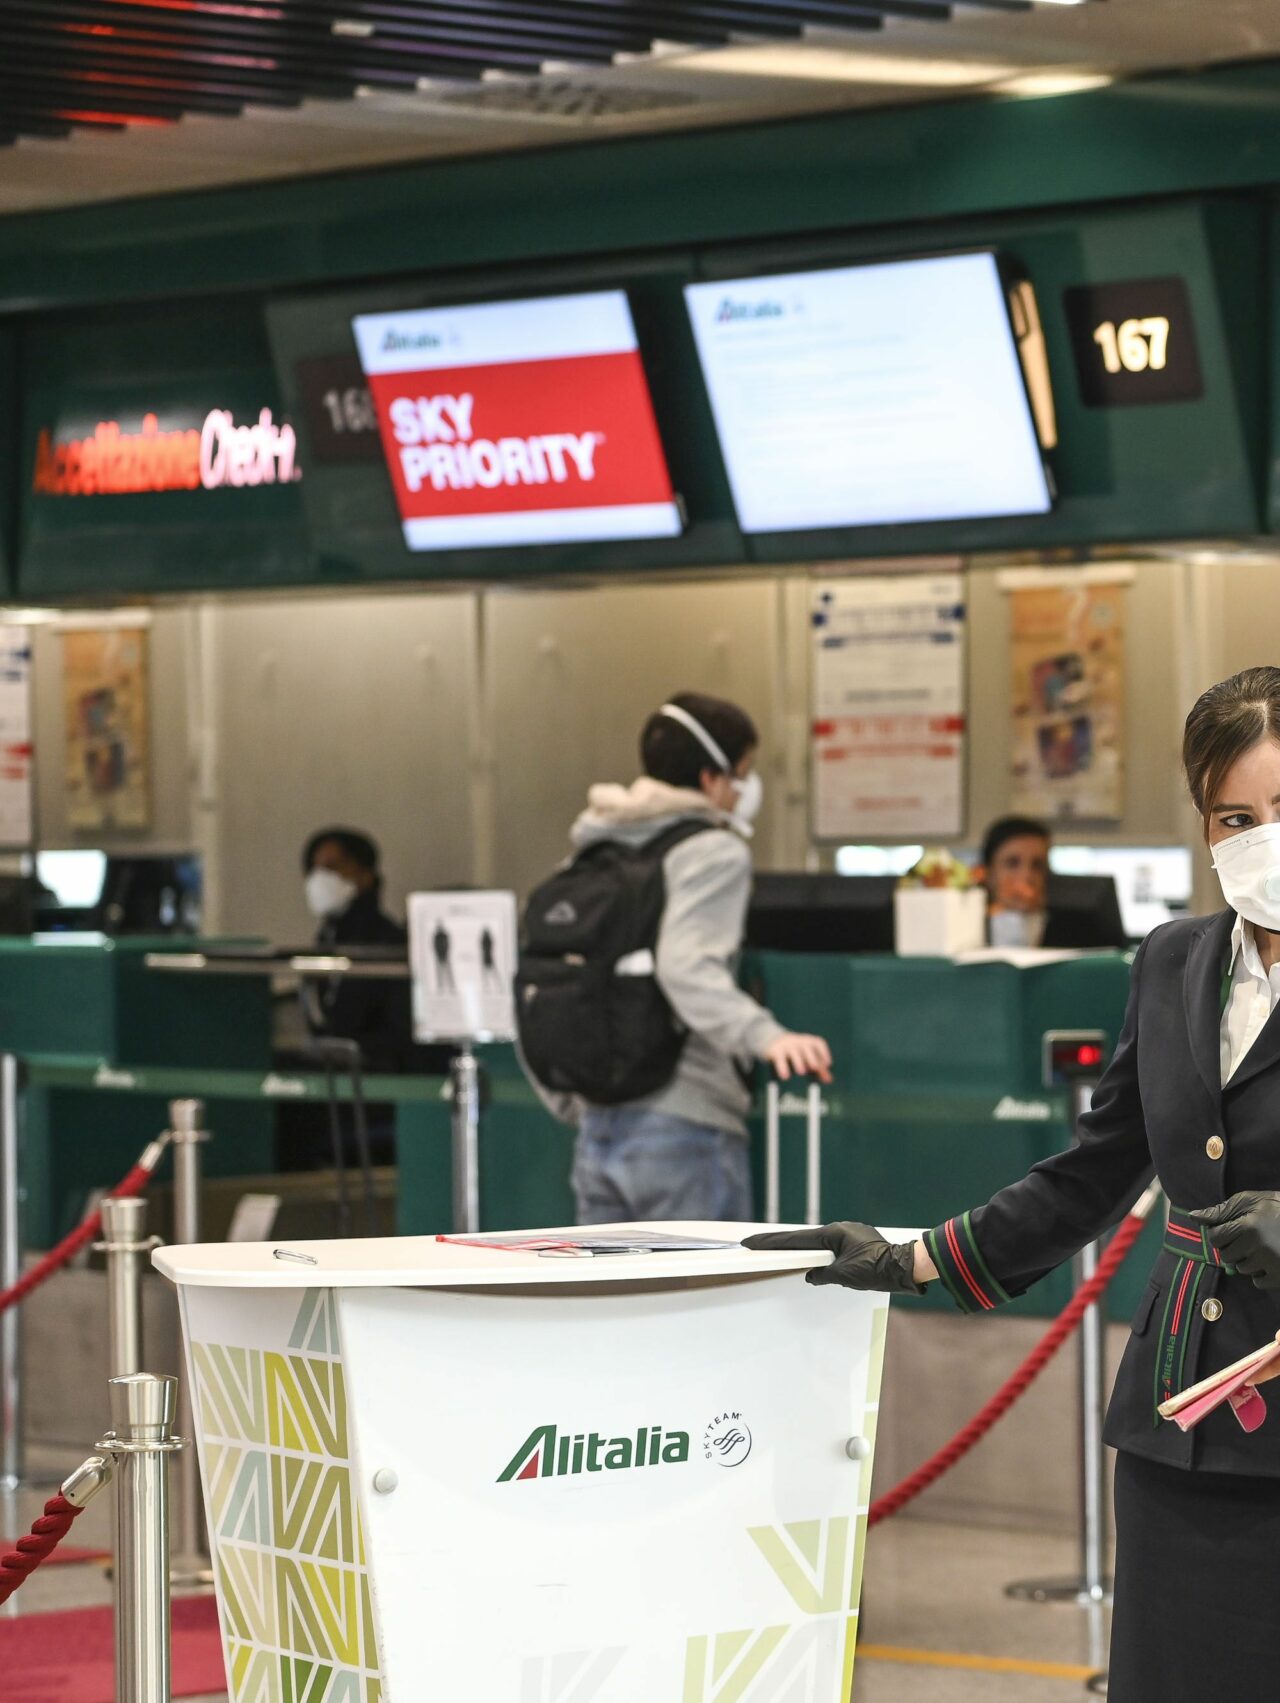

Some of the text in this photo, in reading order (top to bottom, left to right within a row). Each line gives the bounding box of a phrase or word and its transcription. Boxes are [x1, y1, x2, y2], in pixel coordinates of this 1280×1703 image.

[1093, 316, 1170, 374] 167
[389, 392, 474, 445] SKY
[400, 432, 597, 493] PRIORITY
[1161, 1335, 1177, 1391] Alitalia
[495, 1411, 742, 1483] Alitalia SKYTEAM
